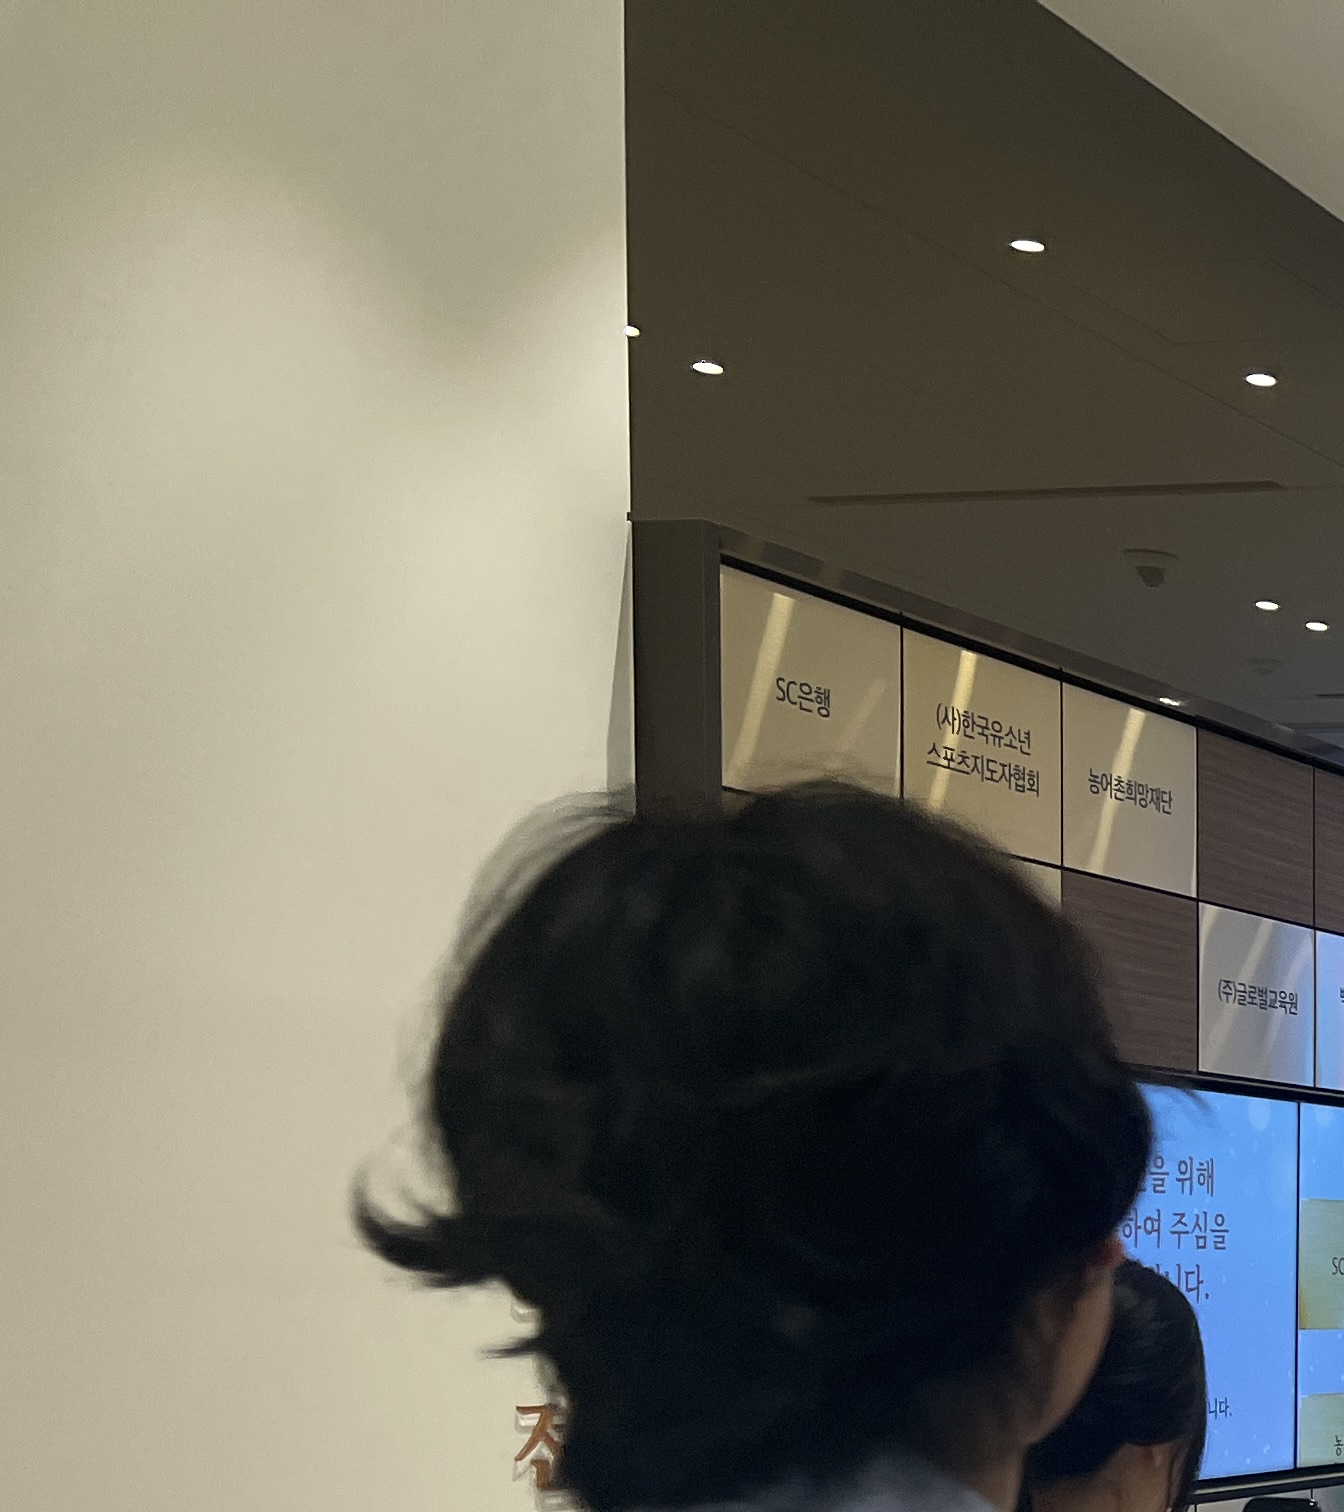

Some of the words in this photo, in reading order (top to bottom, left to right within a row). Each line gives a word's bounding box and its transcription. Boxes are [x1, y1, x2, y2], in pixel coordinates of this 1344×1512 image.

[776, 677, 831, 719] SC은행
[936, 703, 1032, 756] (사)한국유소년
[926, 744, 1041, 799] 스포츠지도자협회
[1088, 767, 1173, 817] 농어촌희망재단
[1217, 978, 1299, 1016] (주)글로벌교육원
[1175, 1155, 1215, 1198] 위해
[1169, 1210, 1231, 1251] 주심을
